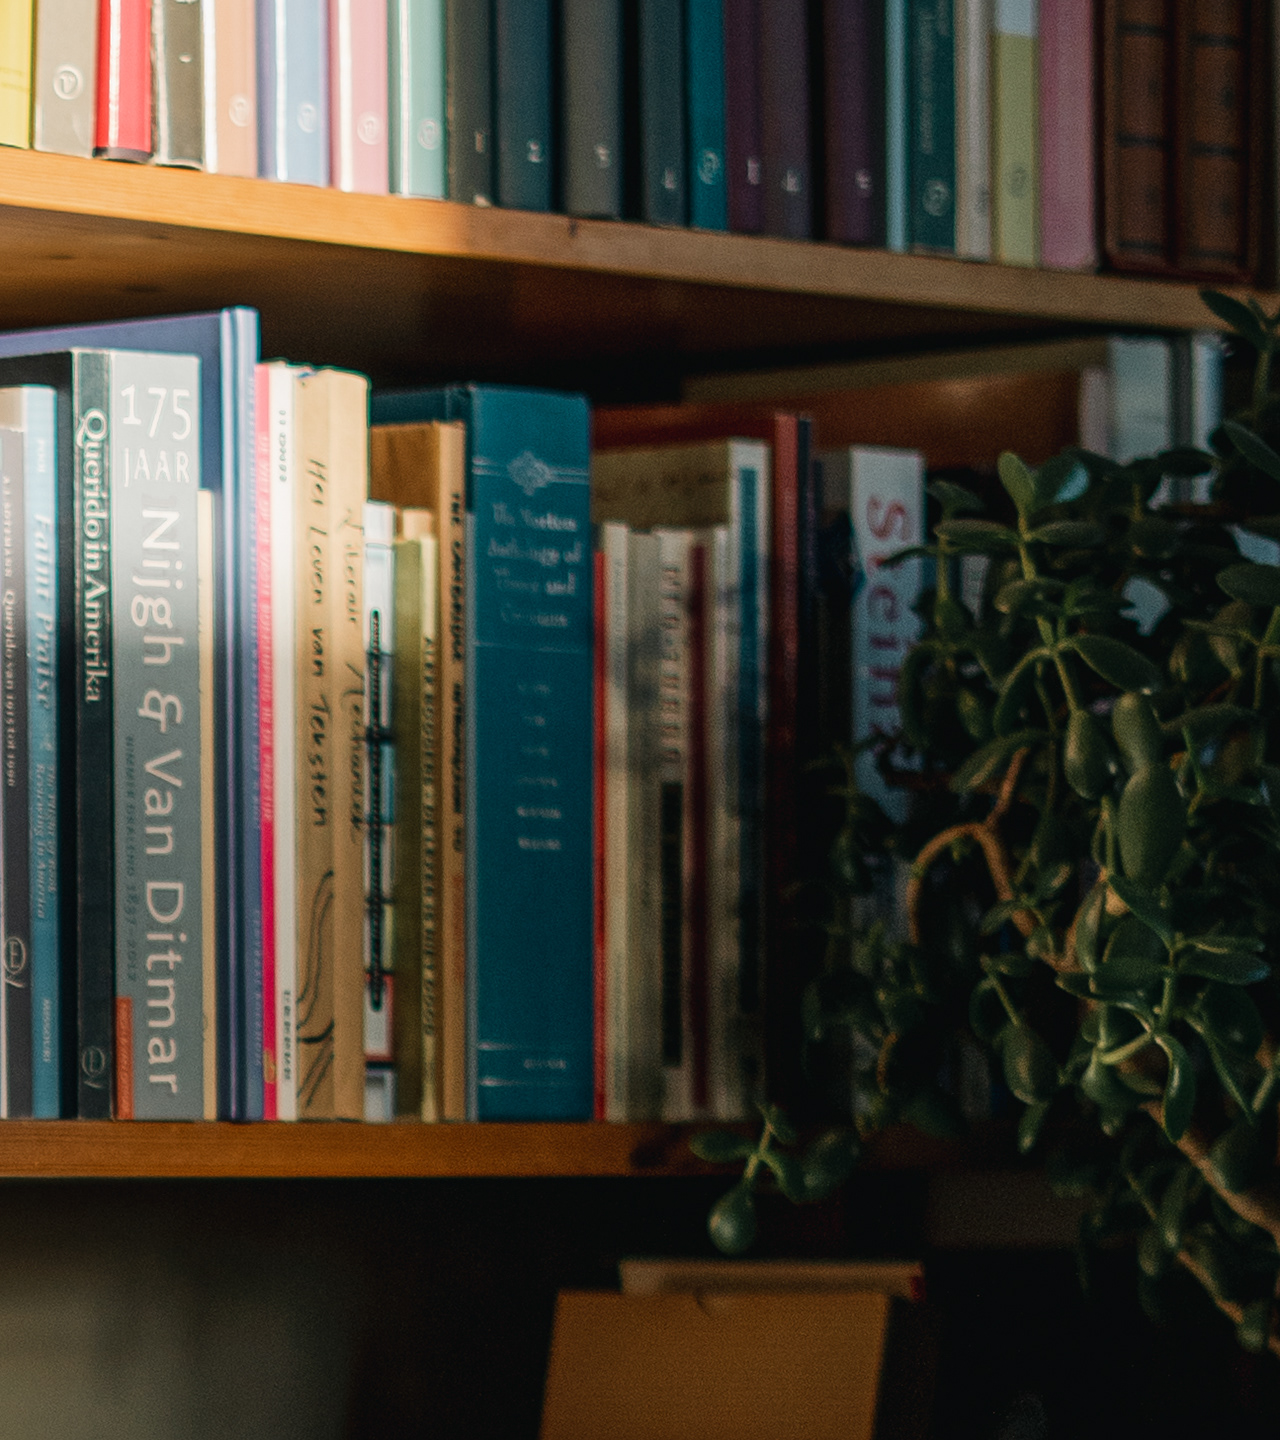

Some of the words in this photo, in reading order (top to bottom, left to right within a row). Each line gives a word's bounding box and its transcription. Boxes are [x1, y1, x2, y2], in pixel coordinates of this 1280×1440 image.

[119, 385, 193, 441] 175
[122, 447, 191, 486] JAAR
[76, 408, 107, 539] Querido
[85, 541, 107, 572] in
[129, 507, 183, 670] Nijgh
[84, 575, 108, 703] Amerika
[137, 690, 185, 736] &
[143, 746, 185, 856] Van
[146, 879, 189, 1096] Ditmar
